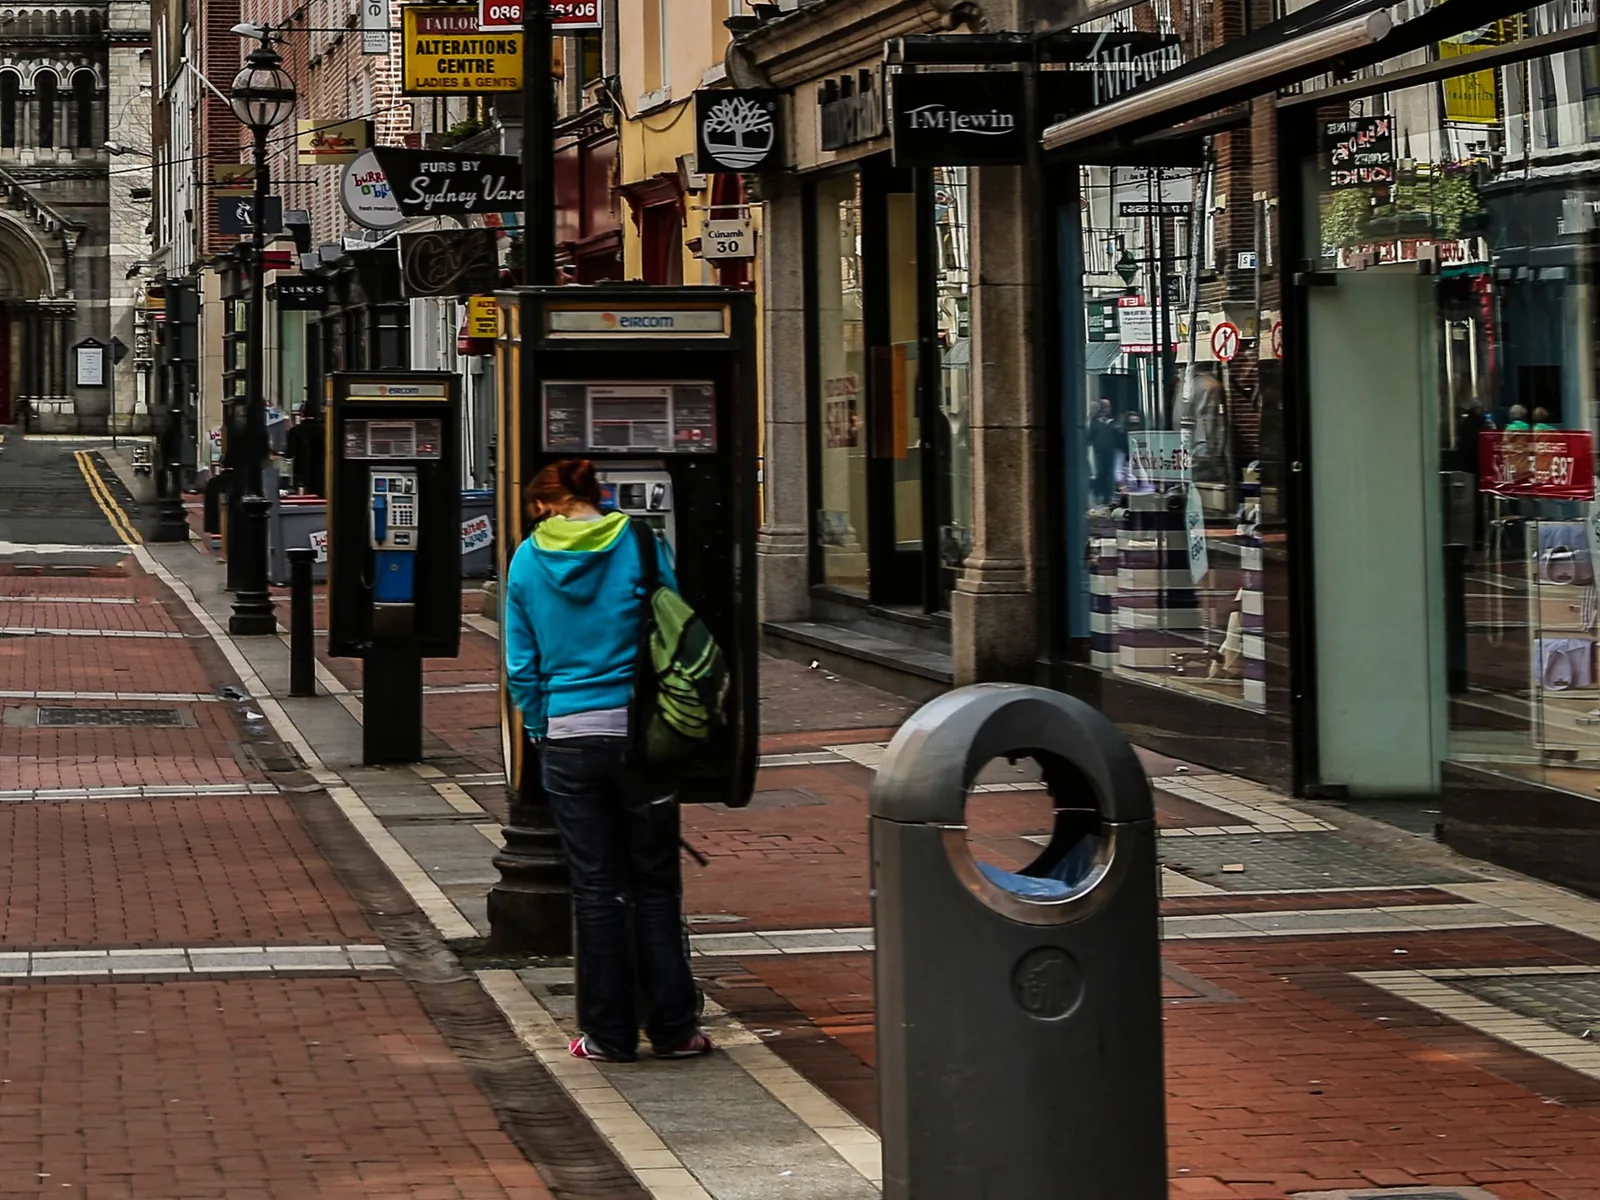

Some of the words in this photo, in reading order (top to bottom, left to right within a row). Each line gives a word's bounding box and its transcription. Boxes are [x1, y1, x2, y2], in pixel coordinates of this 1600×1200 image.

[490, 5, 521, 19] 086
[416, 40, 517, 55] ALTERATIONS
[437, 58, 495, 74] CENTRE
[416, 77, 458, 87] LADIES
[463, 77, 471, 87] &
[475, 77, 517, 87] GENTS
[420, 162, 456, 173] FURS
[462, 161, 481, 172] BY
[402, 176, 477, 211] Sydney
[708, 229, 744, 240] Cúnamh
[716, 241, 739, 253] 30
